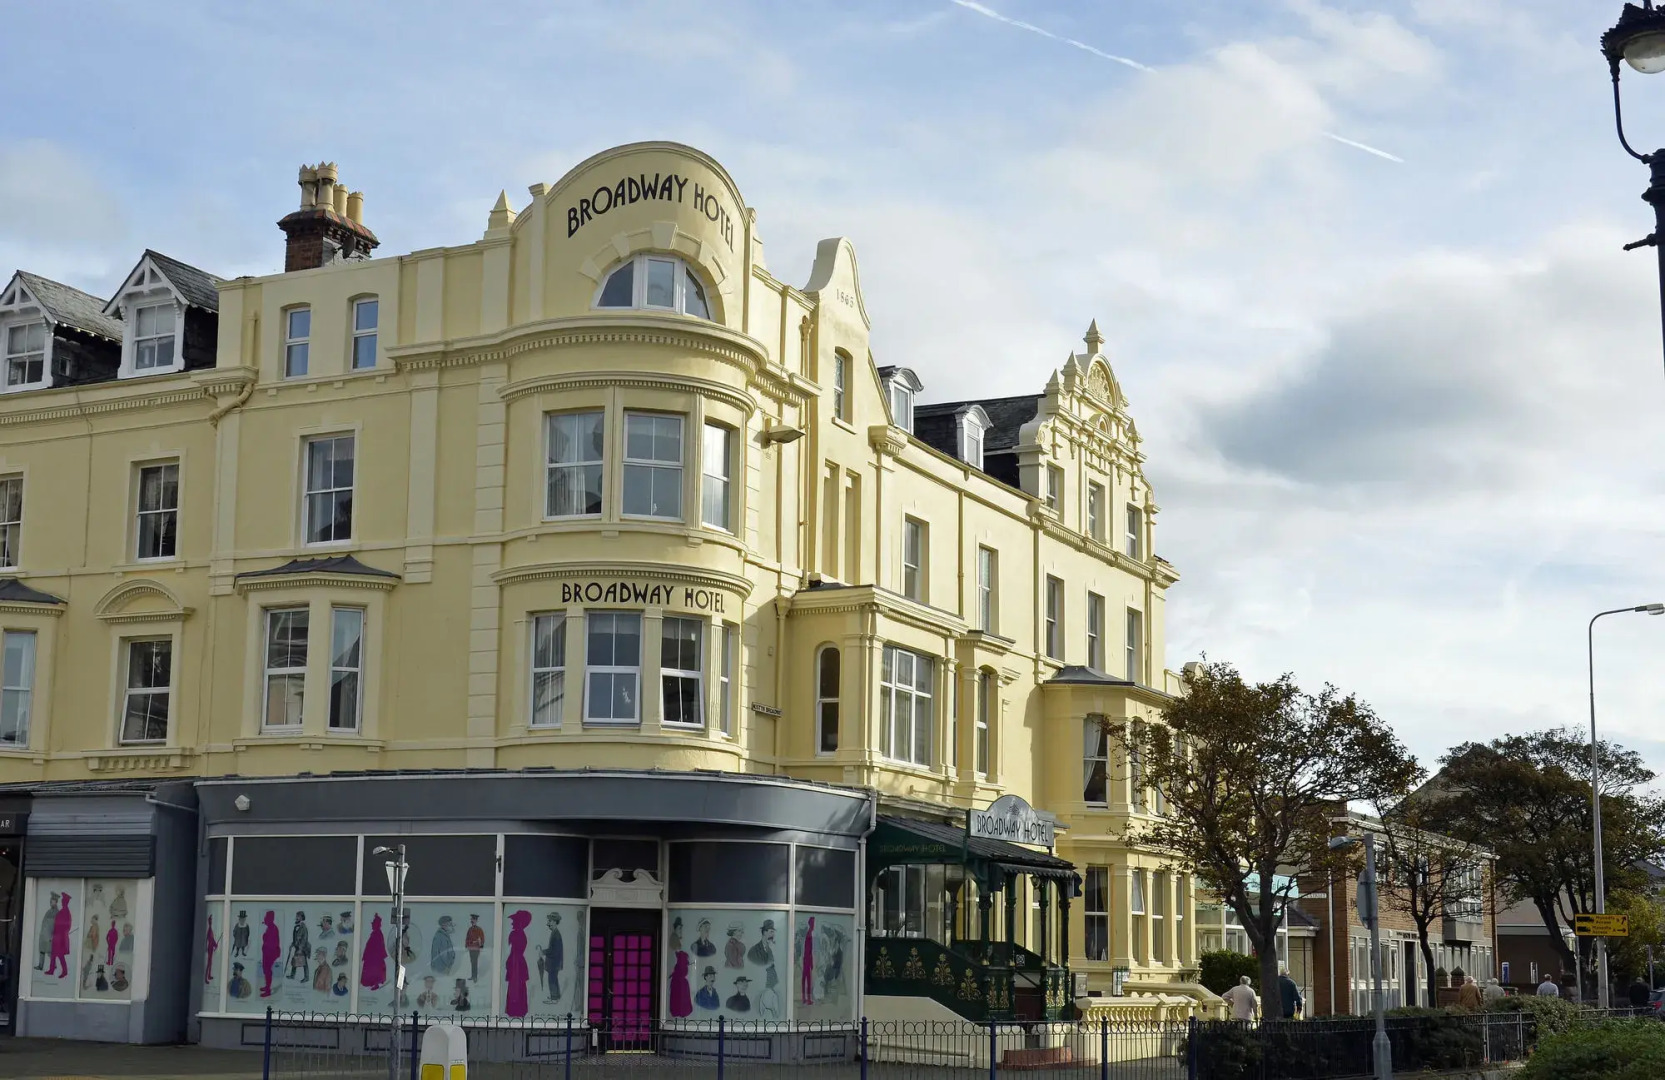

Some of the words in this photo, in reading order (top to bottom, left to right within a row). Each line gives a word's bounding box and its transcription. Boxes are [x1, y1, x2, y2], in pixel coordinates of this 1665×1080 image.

[567, 173, 689, 239] BROADWAY
[693, 183, 734, 253] HOTEL
[561, 582, 674, 605] BROADWAY
[684, 587, 725, 614] HOTEL
[977, 814, 1021, 838] BROADWAY
[1024, 821, 1048, 842] HOTEL
